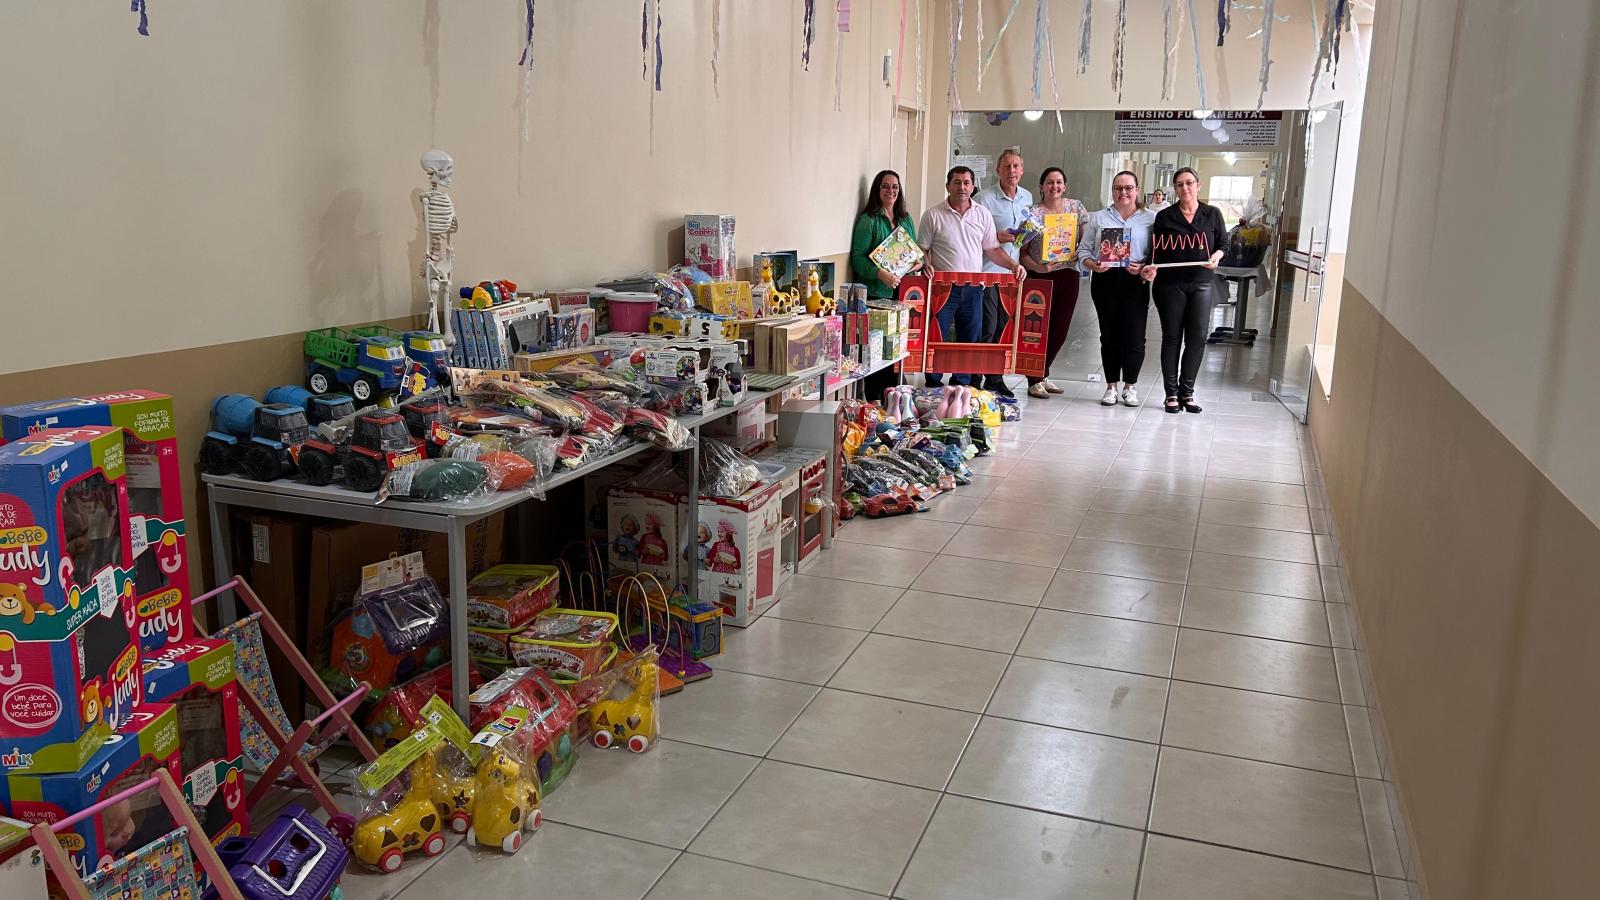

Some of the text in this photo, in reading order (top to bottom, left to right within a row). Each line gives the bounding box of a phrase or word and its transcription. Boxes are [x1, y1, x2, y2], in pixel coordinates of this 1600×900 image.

[702, 322, 710, 336] S
[136, 410, 168, 421] SOU MUITO
[135, 416, 170, 429] FOFINHA DE
[138, 423, 169, 434] ABRAÇAR
[0, 544, 51, 586] udy
[66, 611, 82, 631] SUPER
[139, 606, 183, 643] udy
[703, 623, 716, 653] 5
[12, 701, 52, 711] bebê para
[110, 668, 140, 731] judy
[10, 709, 55, 718] você cuidar
[37, 812, 56, 820] MUITO
